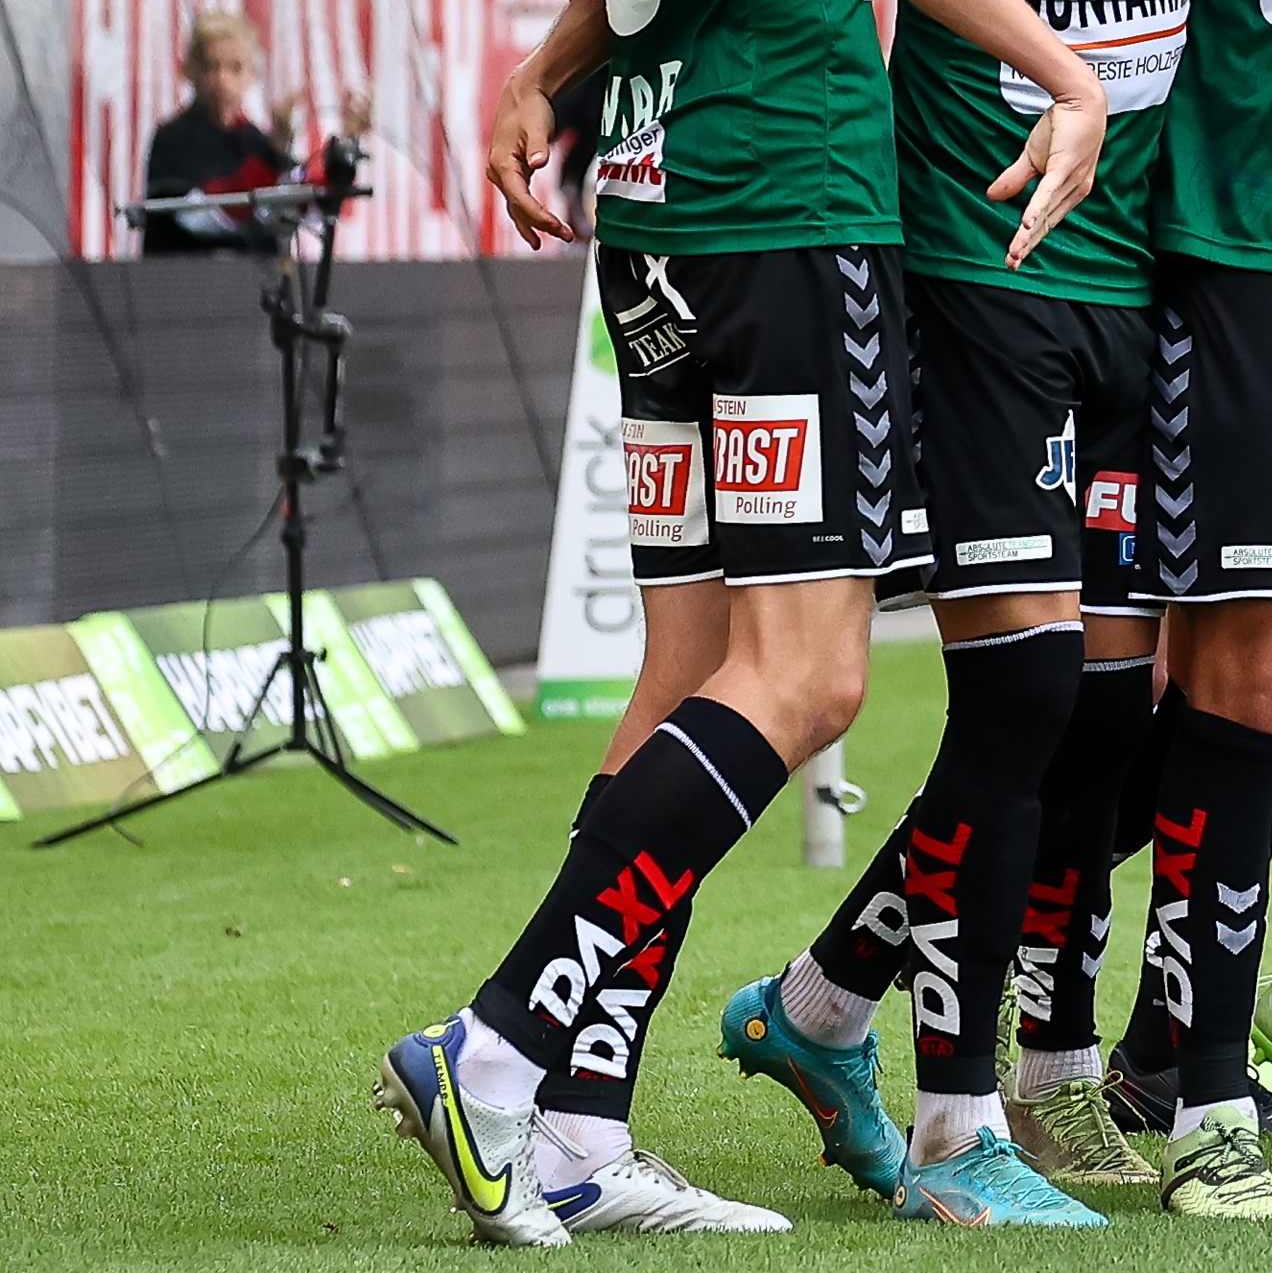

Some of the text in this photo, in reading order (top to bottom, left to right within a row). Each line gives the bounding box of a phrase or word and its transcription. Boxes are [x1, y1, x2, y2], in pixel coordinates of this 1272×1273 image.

[714, 400, 746, 416] STEIN
[571, 414, 637, 636] druck
[627, 452, 684, 509] AST
[632, 519, 684, 542] Polling
[735, 496, 798, 519] Polling
[528, 849, 696, 1028] DAXL
[905, 822, 973, 1039] DAXL
[1153, 807, 1208, 1029] DAXL
